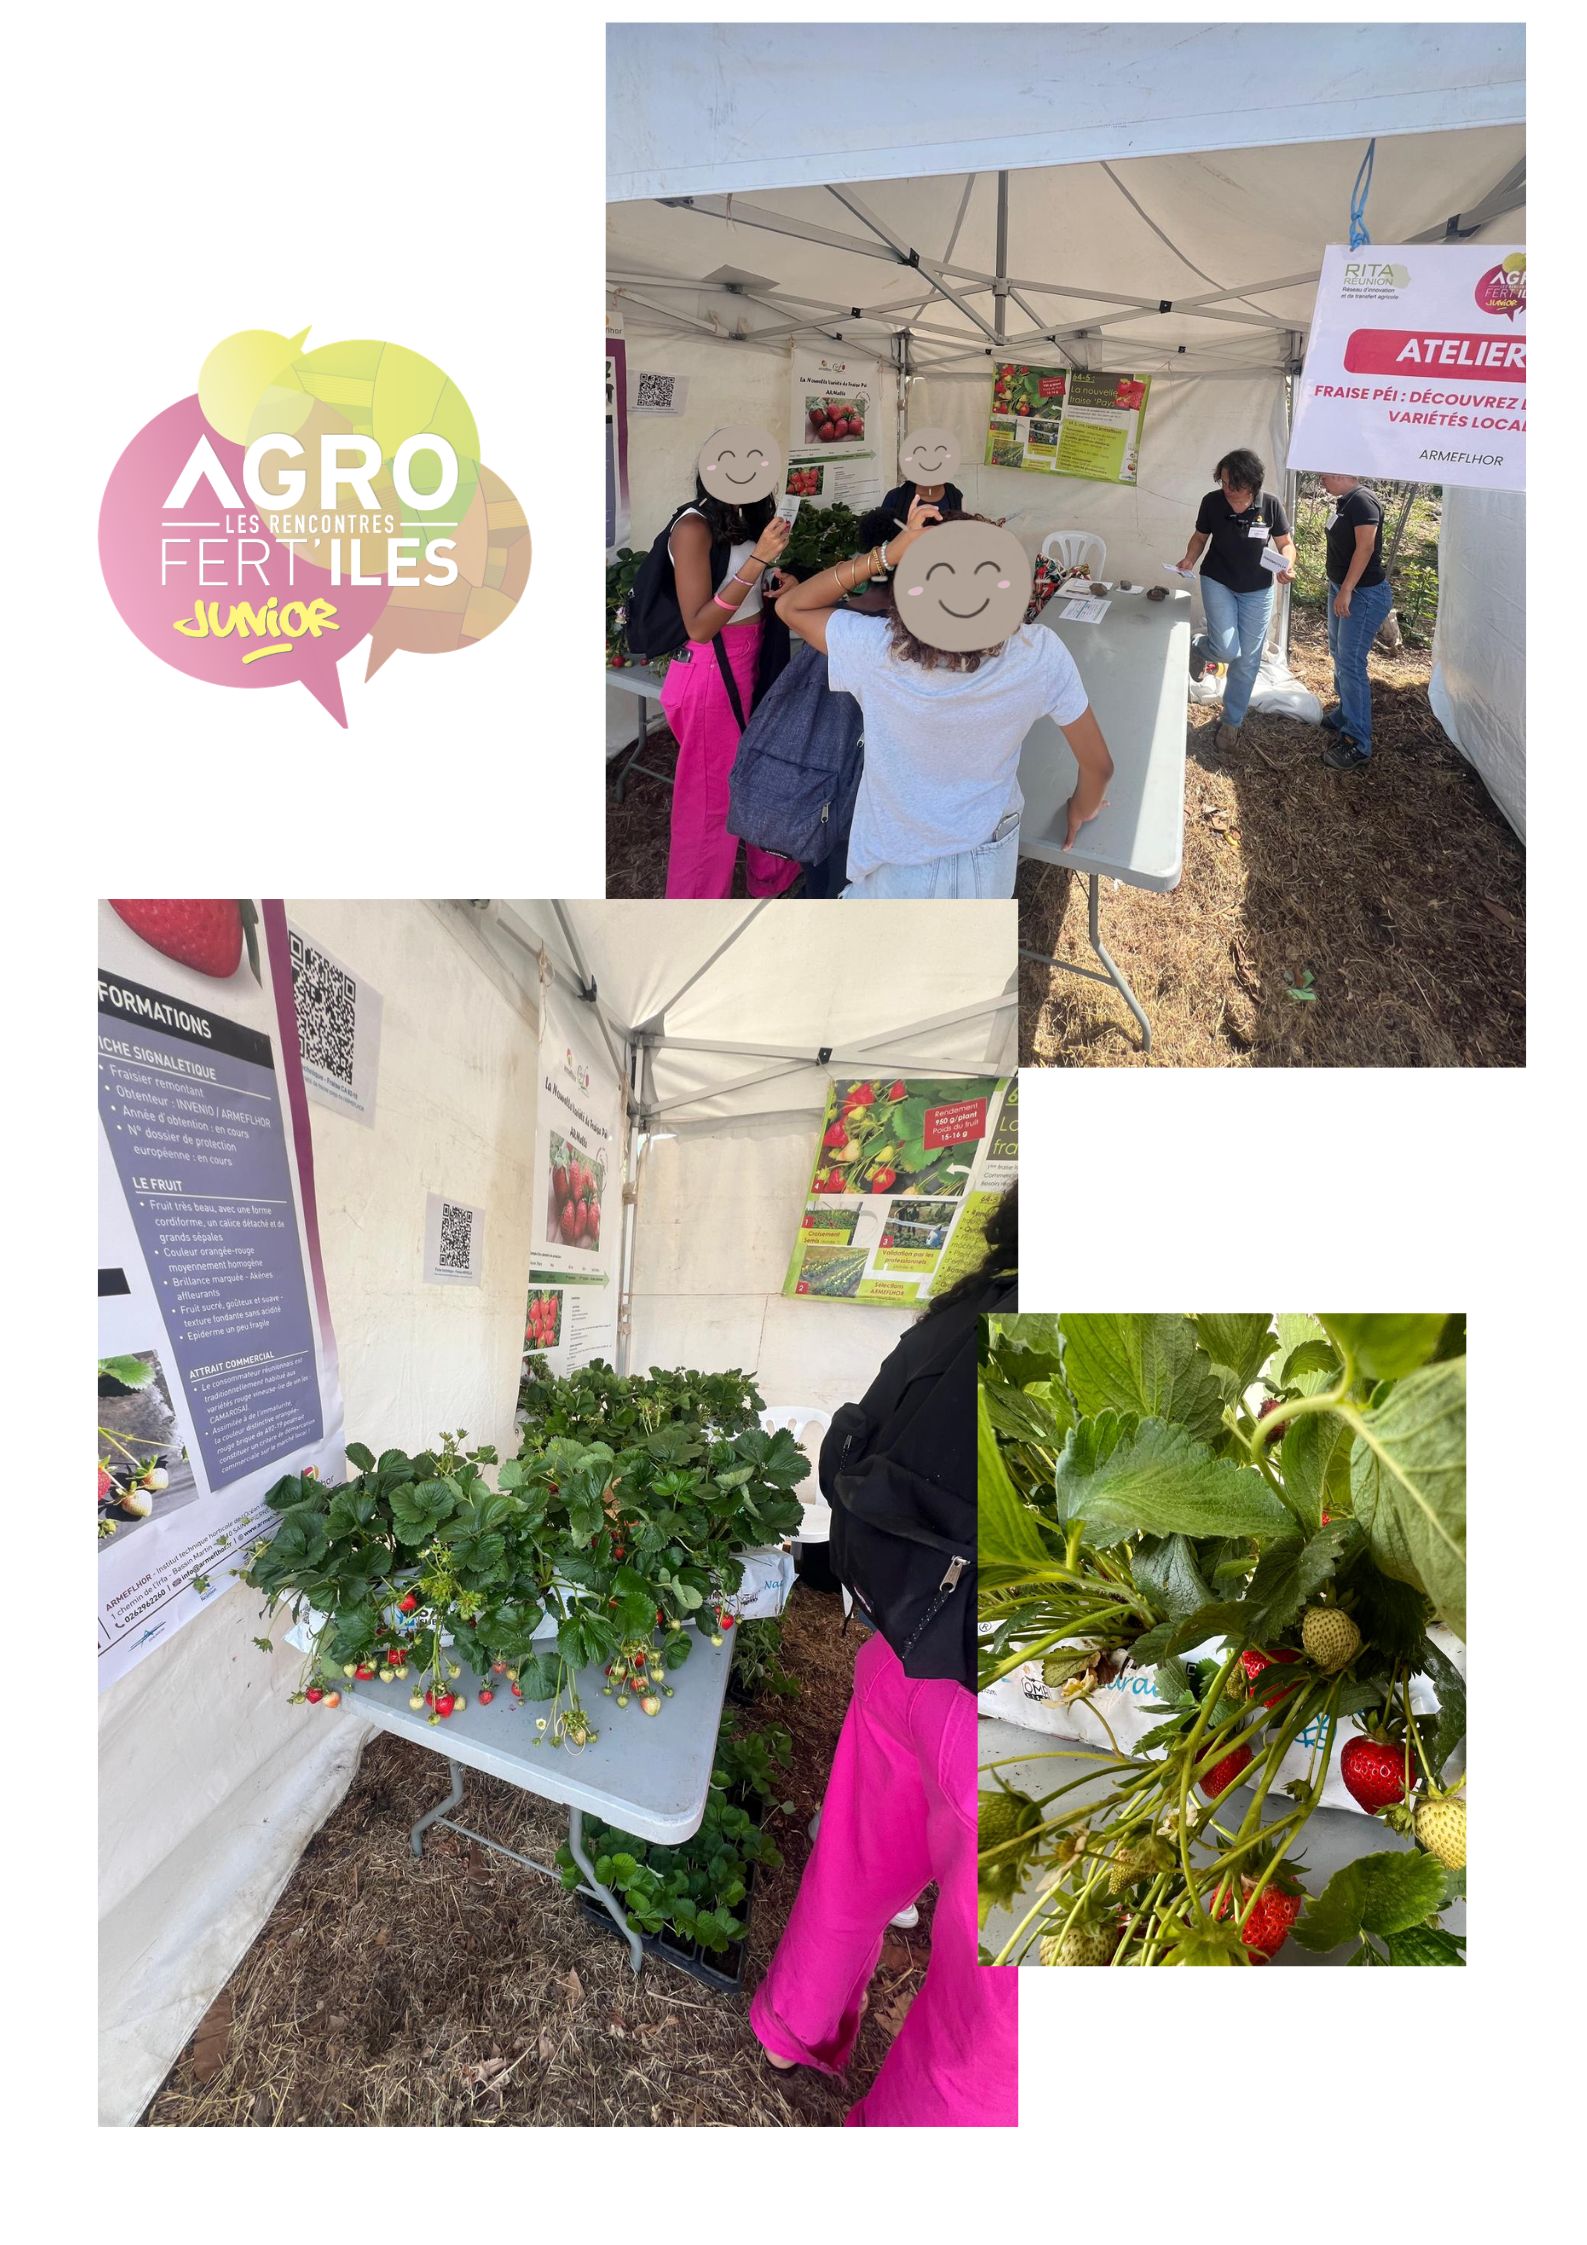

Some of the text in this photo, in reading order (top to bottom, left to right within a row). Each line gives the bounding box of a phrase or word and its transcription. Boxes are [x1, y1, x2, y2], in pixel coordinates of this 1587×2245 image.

[1345, 264, 1394, 278] RITA
[1396, 338, 1526, 369] ATELIER
[1314, 385, 1370, 400] FRAISE
[1372, 386, 1398, 402] PÉI
[1409, 389, 1519, 410] DÉCOUVREZ
[1388, 410, 1468, 428] VARIÉTÉS
[1419, 450, 1504, 466] ARMEFLHOR
[98, 980, 212, 1040] FORMATIONS
[133, 1046, 216, 1081] SIGNALETIQUE
[109, 1064, 204, 1098] Fraisier remontant
[116, 1085, 271, 1128] Obtenteur INVENIO ARMEFLHOR
[123, 1104, 156, 1122] Année
[227, 1126, 250, 1139] cours
[145, 1126, 180, 1142] dossier
[182, 1133, 194, 1146] de
[196, 1136, 238, 1152] protection
[134, 1145, 190, 1162] européenne
[210, 1156, 232, 1167] cours
[132, 1176, 183, 1192] LE FRUIT
[150, 1200, 173, 1212] Fruit
[160, 1232, 191, 1244] grands
[164, 1246, 198, 1258] Couleur
[168, 1262, 227, 1274] moyennement
[172, 1276, 210, 1288] Brillance
[180, 1303, 201, 1314] Fruit
[184, 1316, 212, 1328] texture
[190, 1350, 274, 1380] ATTRAIT COMMERCIAL
[106, 1573, 152, 1612] ARMEFLHOR
[117, 1594, 144, 1616] chemin
